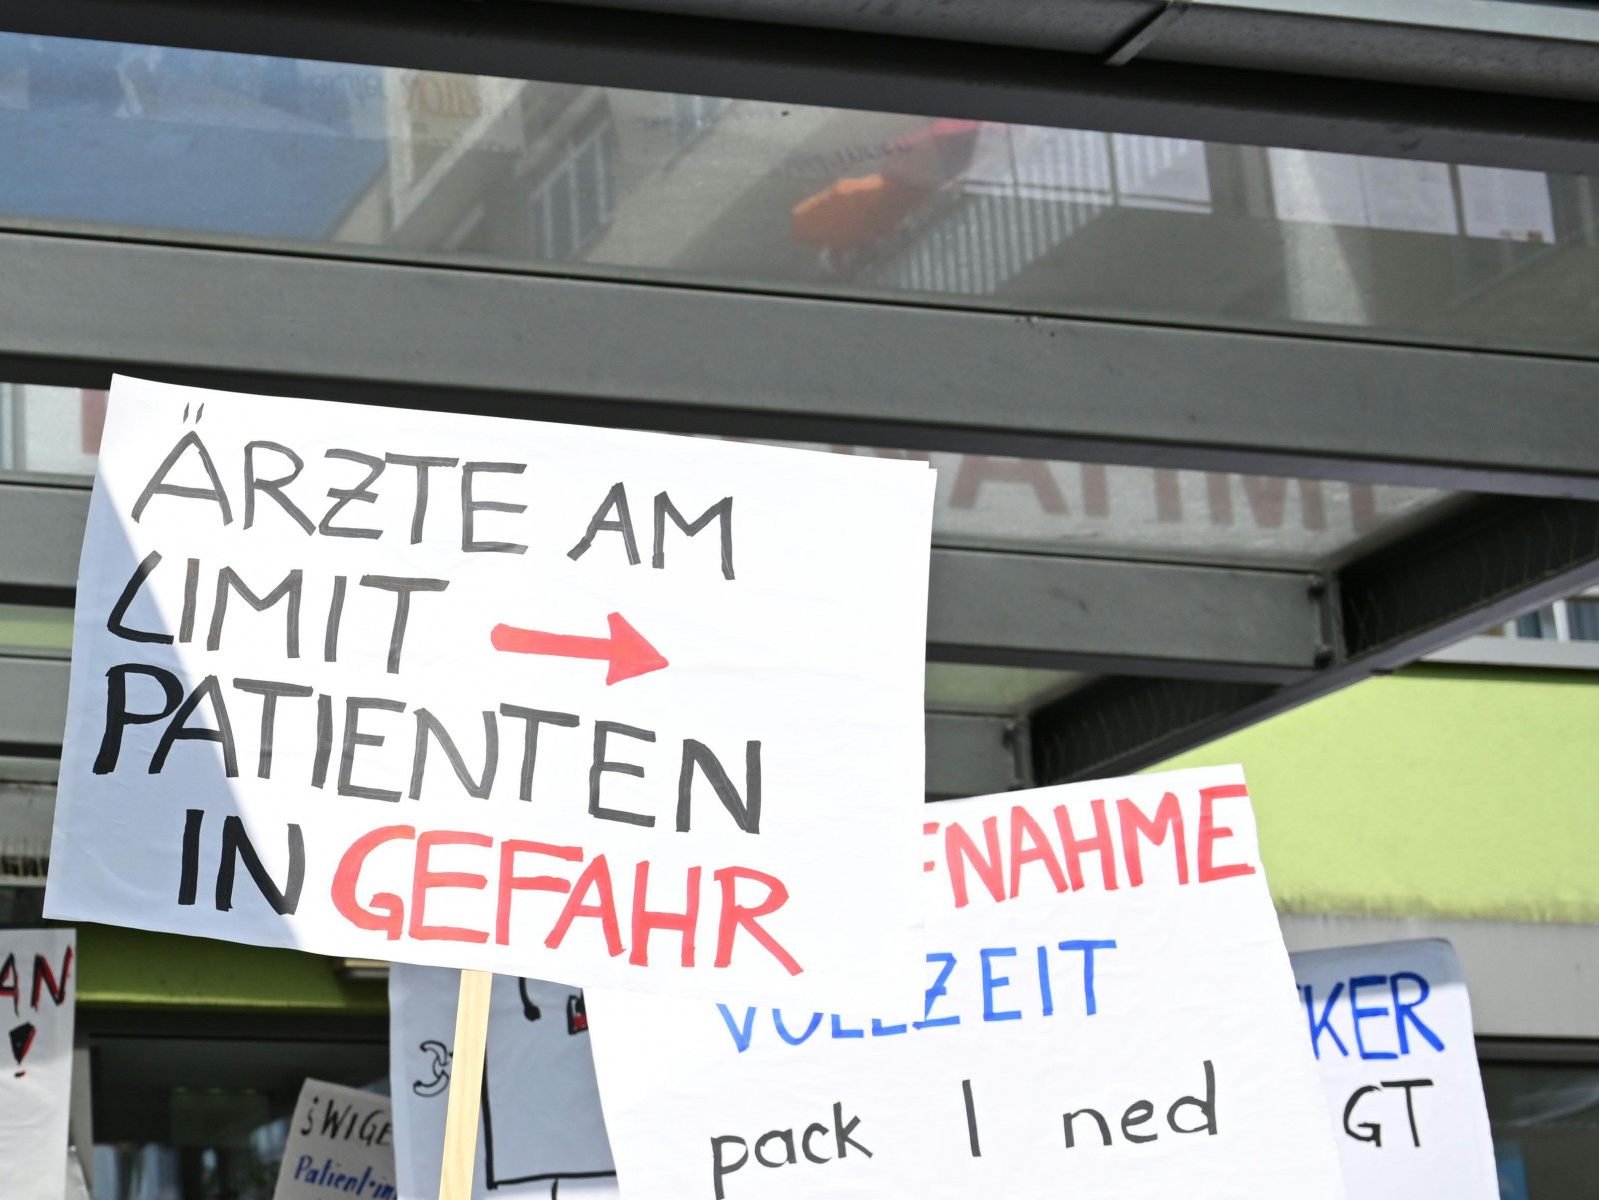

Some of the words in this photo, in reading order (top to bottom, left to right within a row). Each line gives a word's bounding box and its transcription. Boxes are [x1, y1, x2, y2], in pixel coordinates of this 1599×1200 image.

[131, 403, 528, 555] ÄRZTE
[566, 481, 736, 581] AM
[107, 551, 450, 675] LIMIT
[92, 662, 762, 835] PATIENTEN
[178, 808, 305, 917] IN
[330, 824, 805, 977] GEFAHR
[1296, 971, 1445, 1061] KER
[1062, 1060, 1219, 1151] ned
